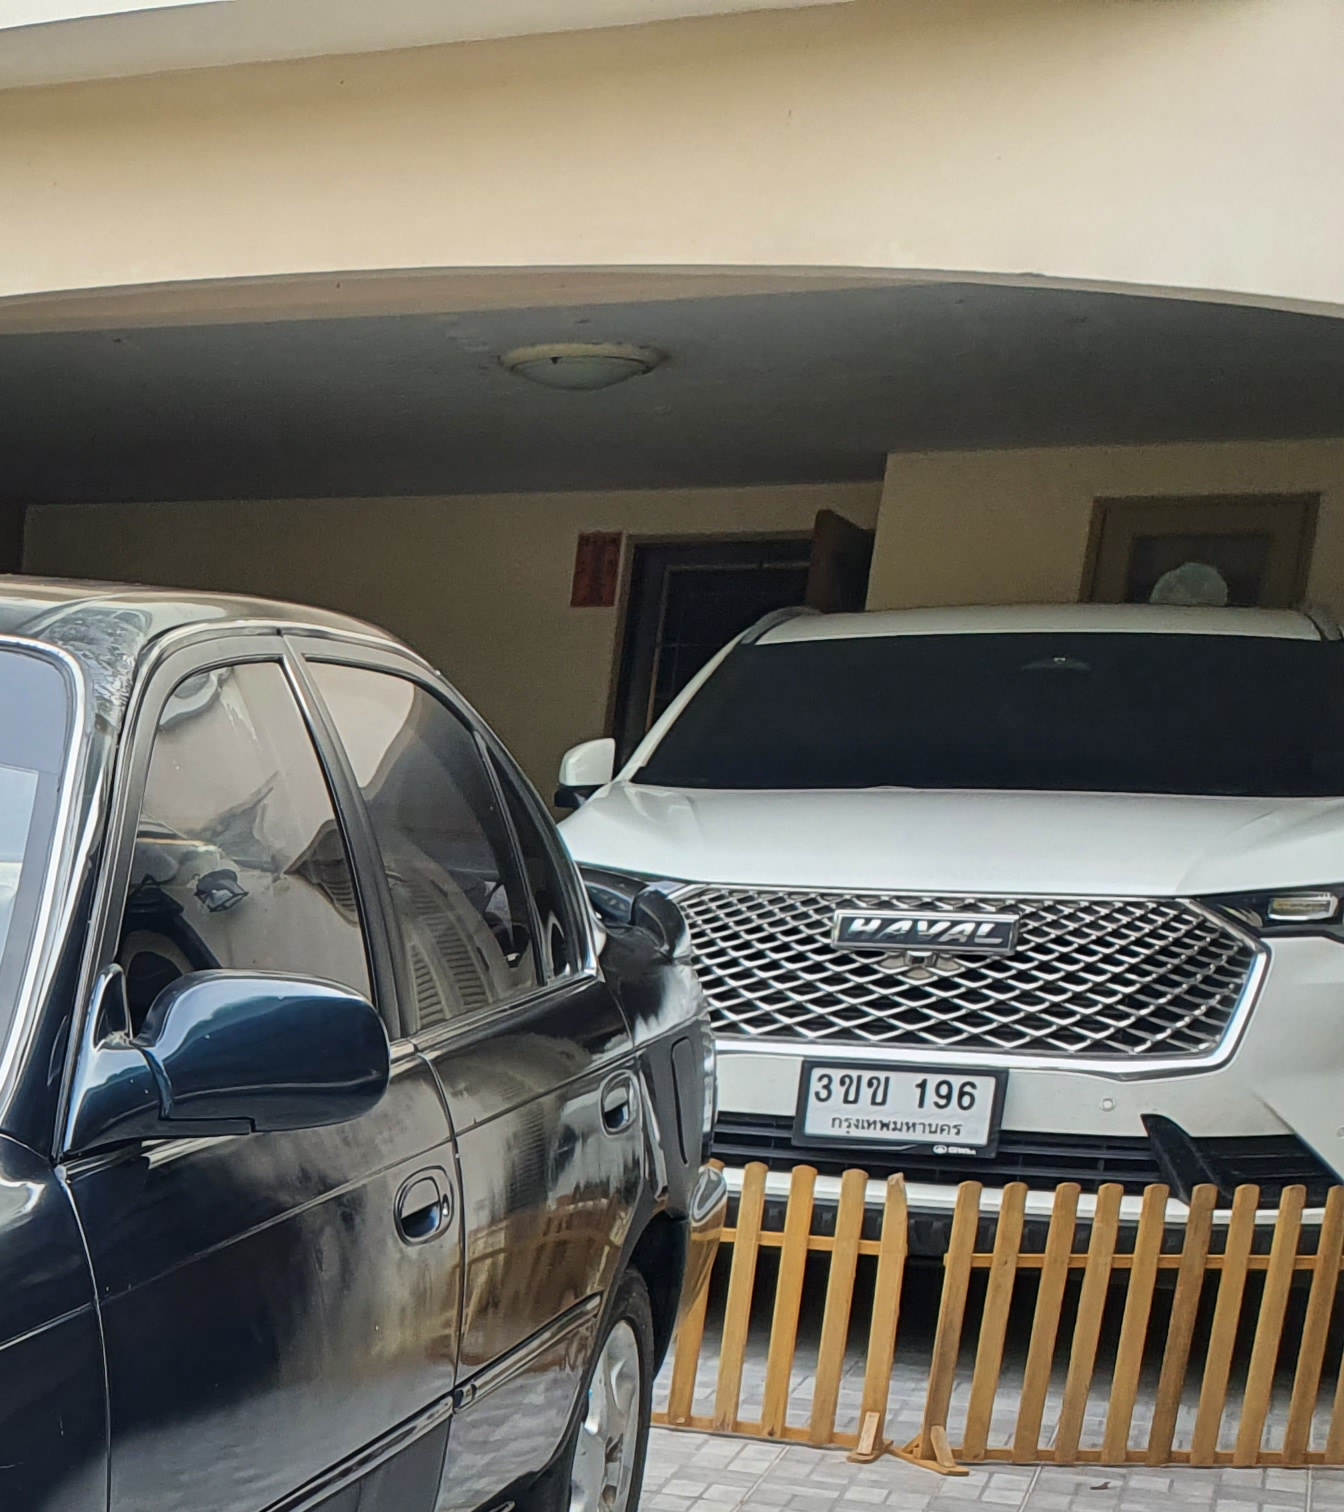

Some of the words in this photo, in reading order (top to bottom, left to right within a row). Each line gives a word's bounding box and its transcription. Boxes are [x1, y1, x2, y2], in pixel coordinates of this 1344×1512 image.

[846, 918, 1004, 944] HAVAL
[915, 1078, 978, 1111] 196
[831, 1116, 963, 1136] กรุงเทพมหานคร
